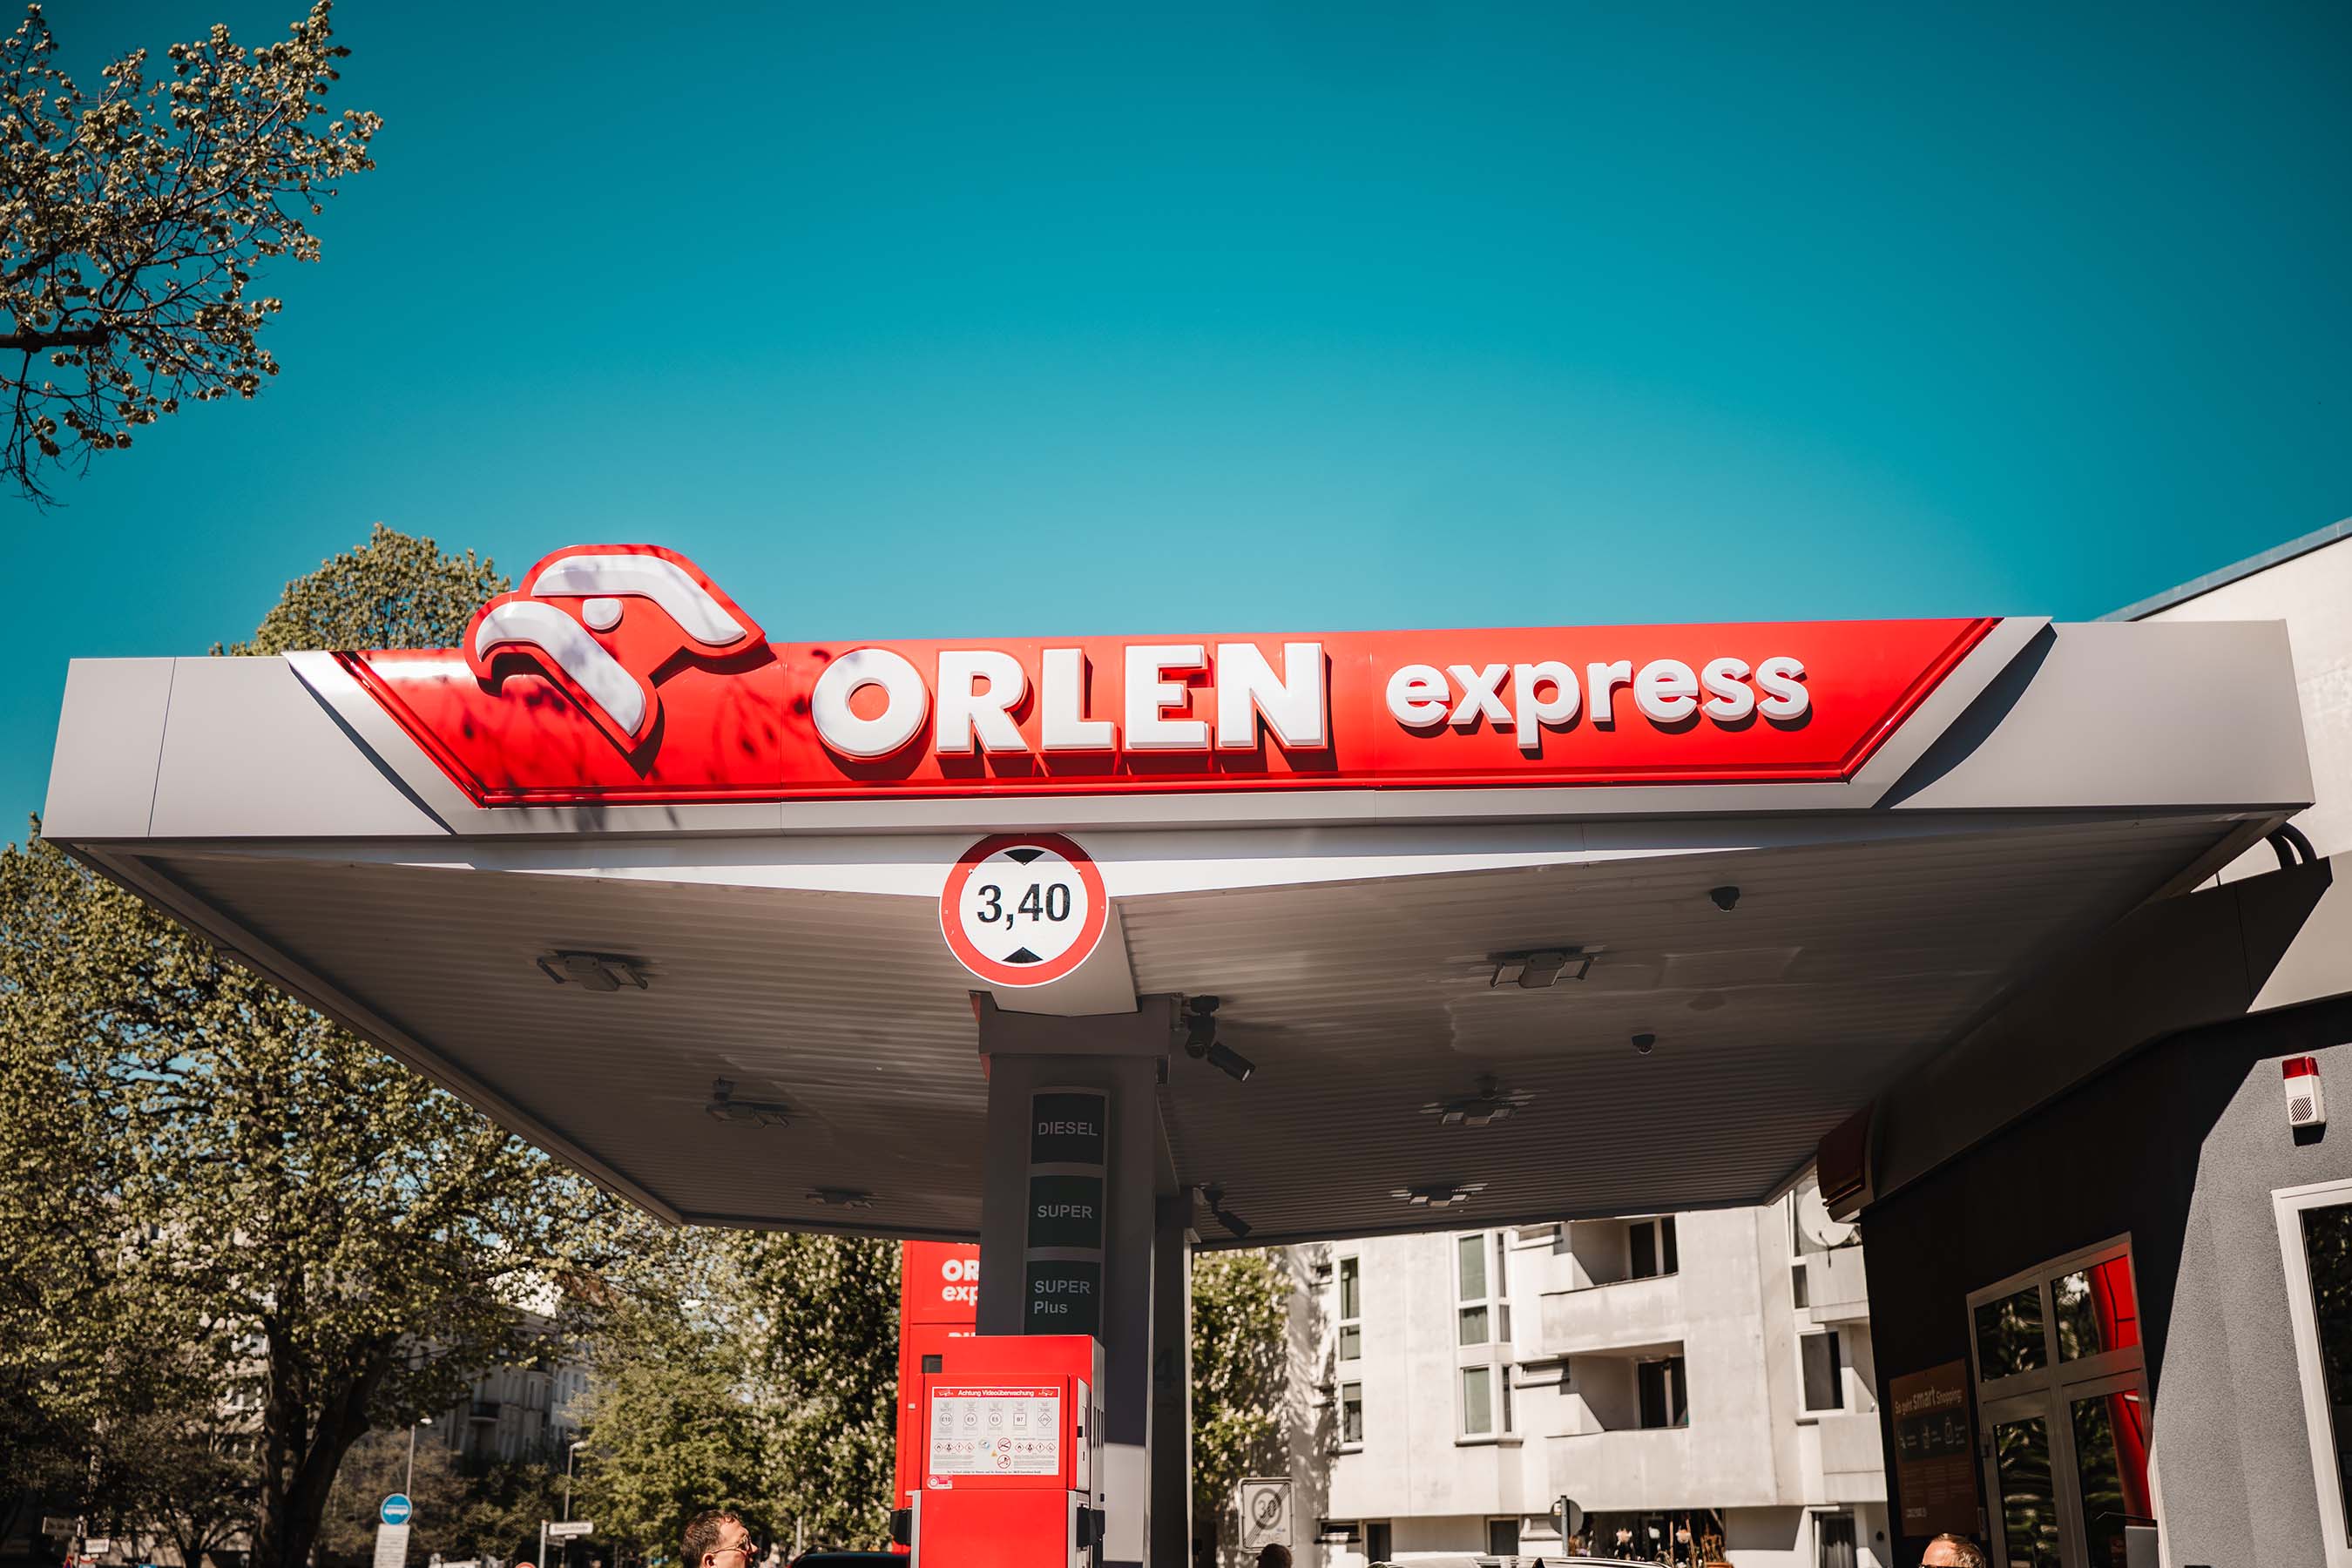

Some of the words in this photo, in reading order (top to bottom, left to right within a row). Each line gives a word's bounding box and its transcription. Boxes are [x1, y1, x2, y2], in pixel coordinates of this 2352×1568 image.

[811, 641, 1328, 759] ORLEN
[1385, 656, 1810, 749] express
[977, 882, 1071, 930] 3,40
[1037, 1121, 1098, 1136] DIESEL
[1037, 1204, 1093, 1219] SUPER
[1034, 1280, 1091, 1294] SUPER
[1033, 1301, 1069, 1314] Plus
[957, 1389, 982, 1397] Achtung
[982, 1389, 1035, 1397] Videoüberwachung
[1913, 1386, 1936, 1410] smart
[1257, 1499, 1277, 1517] 30
